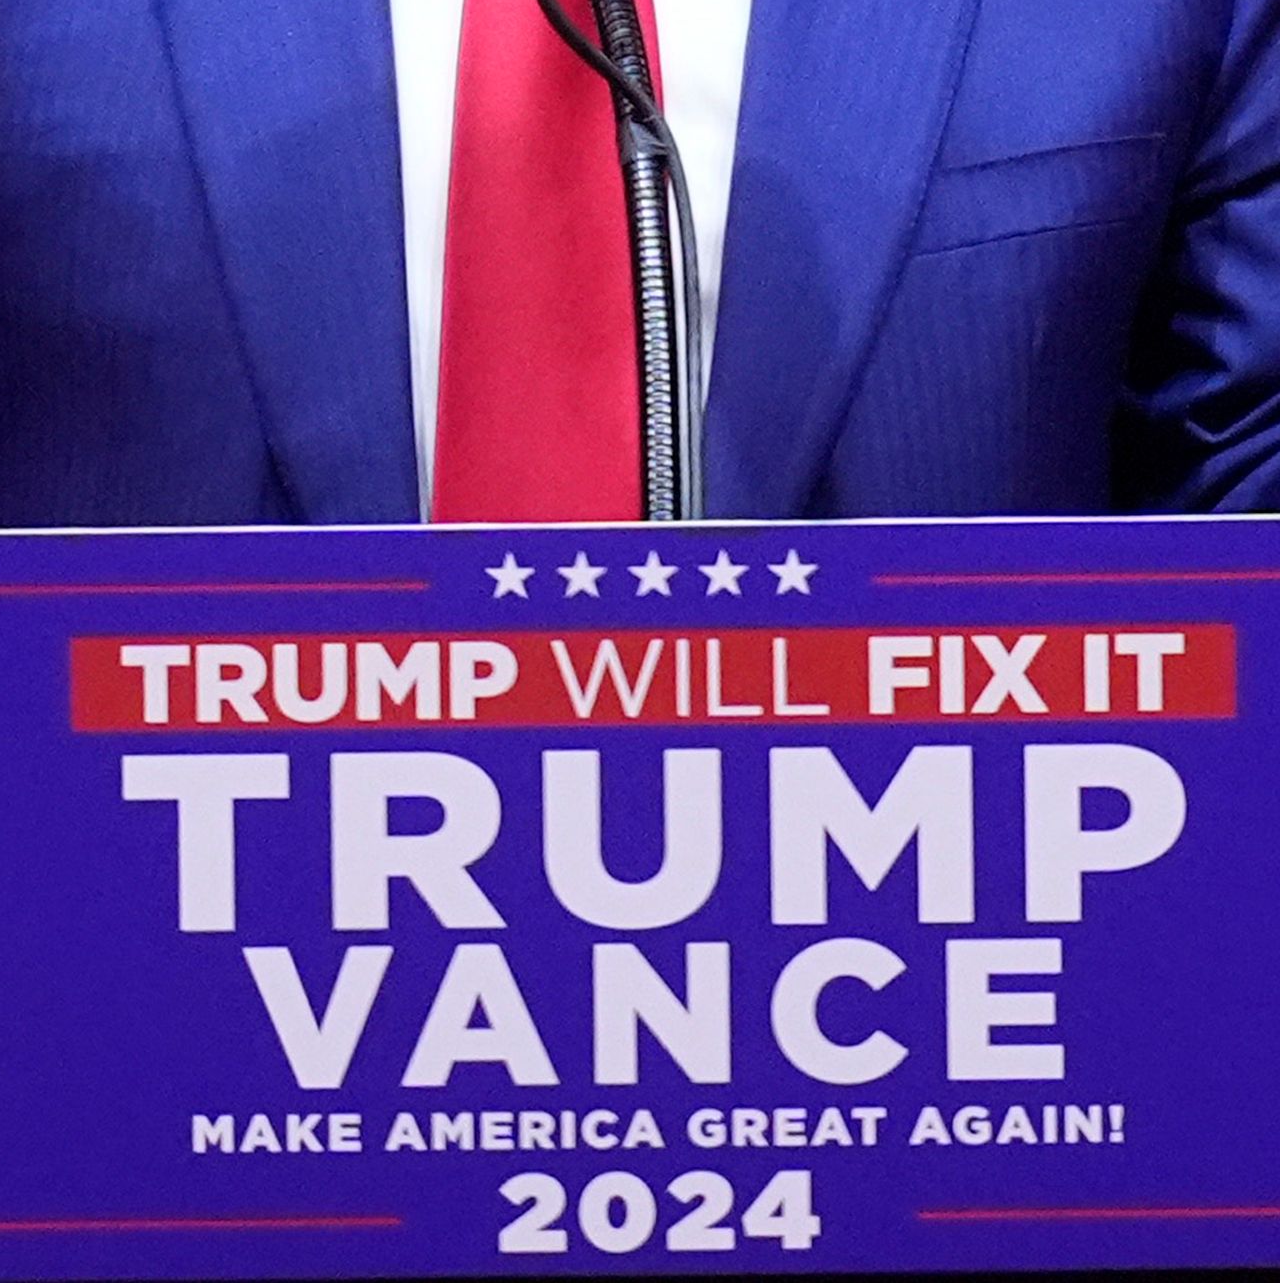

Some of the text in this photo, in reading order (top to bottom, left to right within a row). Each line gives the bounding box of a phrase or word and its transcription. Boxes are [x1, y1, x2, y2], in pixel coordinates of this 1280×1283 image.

[120, 632, 1185, 724] TRUMP WILL FIX IT
[121, 743, 1187, 932] TRUMP
[242, 937, 1065, 1090] VANCE
[192, 1104, 1125, 1154] MAKE AMERICA GREAT AGAIN!
[498, 1170, 821, 1254] 2024
